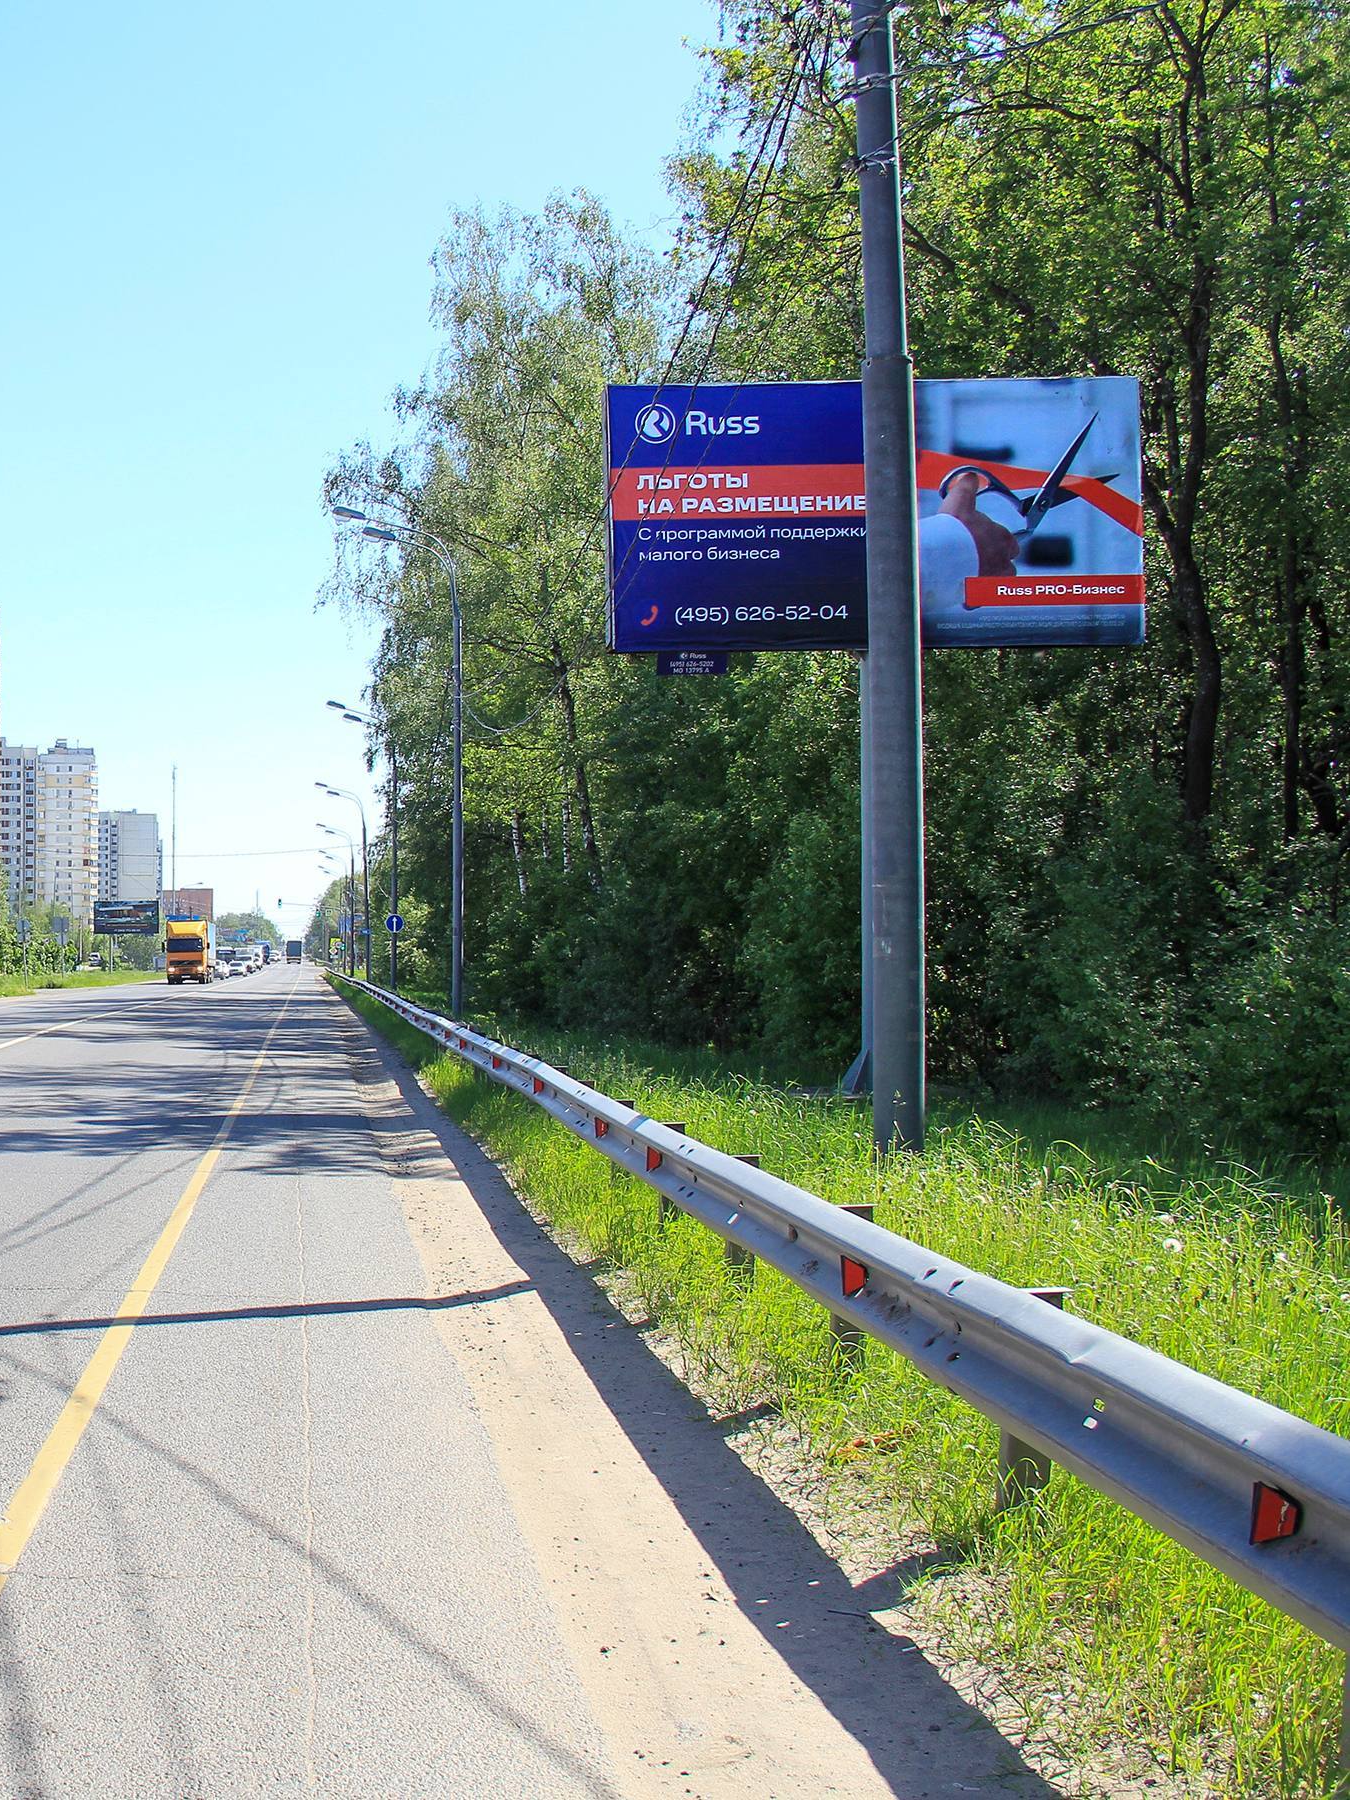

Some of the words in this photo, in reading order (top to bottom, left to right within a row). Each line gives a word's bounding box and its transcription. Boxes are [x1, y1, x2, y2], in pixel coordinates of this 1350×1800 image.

[686, 410, 760, 435] Russ
[636, 473, 749, 490] ЛЬГОТЫ
[638, 498, 675, 514] НА
[681, 495, 867, 514] РАЗМЕЩЕНИЕ
[638, 528, 652, 541] С
[656, 525, 766, 543] программой
[639, 549, 703, 561] малого
[707, 546, 780, 560] бизнеса
[997, 585, 1033, 596] Russ
[1035, 584, 1125, 595] PRO-Бизнес
[675, 606, 730, 626] (495)
[735, 605, 849, 622] 626-52-04
